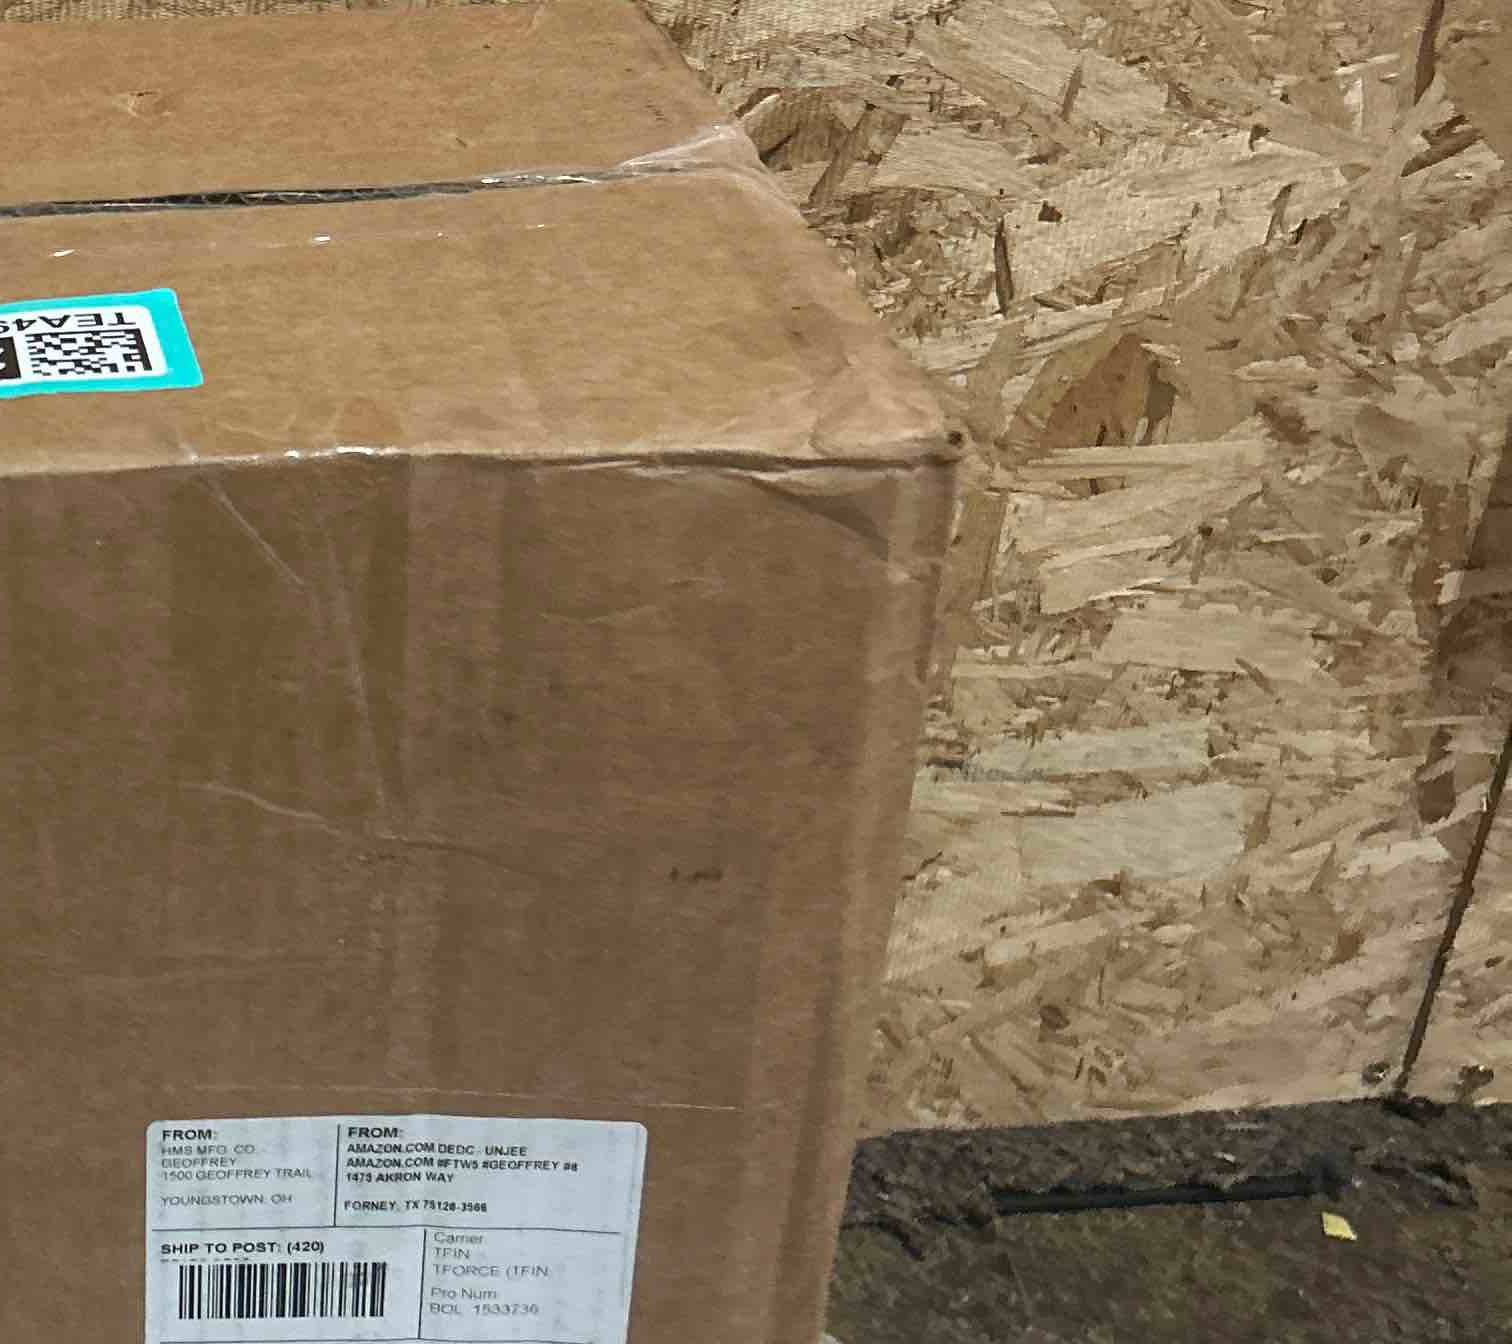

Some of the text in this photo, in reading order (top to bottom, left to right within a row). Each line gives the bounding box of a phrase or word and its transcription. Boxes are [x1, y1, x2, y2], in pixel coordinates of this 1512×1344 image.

[346, 1143, 435, 1154] AMAZON.COM
[161, 1156, 237, 1168] GEOFFREY
[346, 1157, 434, 1168] AMAZON.COM
[195, 1167, 271, 1181] GEOFFREY
[275, 1167, 312, 1178] TRAIL
[375, 1172, 422, 1183] AKRON
[426, 1172, 454, 1183] WAY
[271, 1193, 293, 1204] OH
[160, 1243, 199, 1254] SHIP
[205, 1243, 227, 1253] TO
[287, 1241, 325, 1255] (420)
[430, 1287, 456, 1299] Pro
